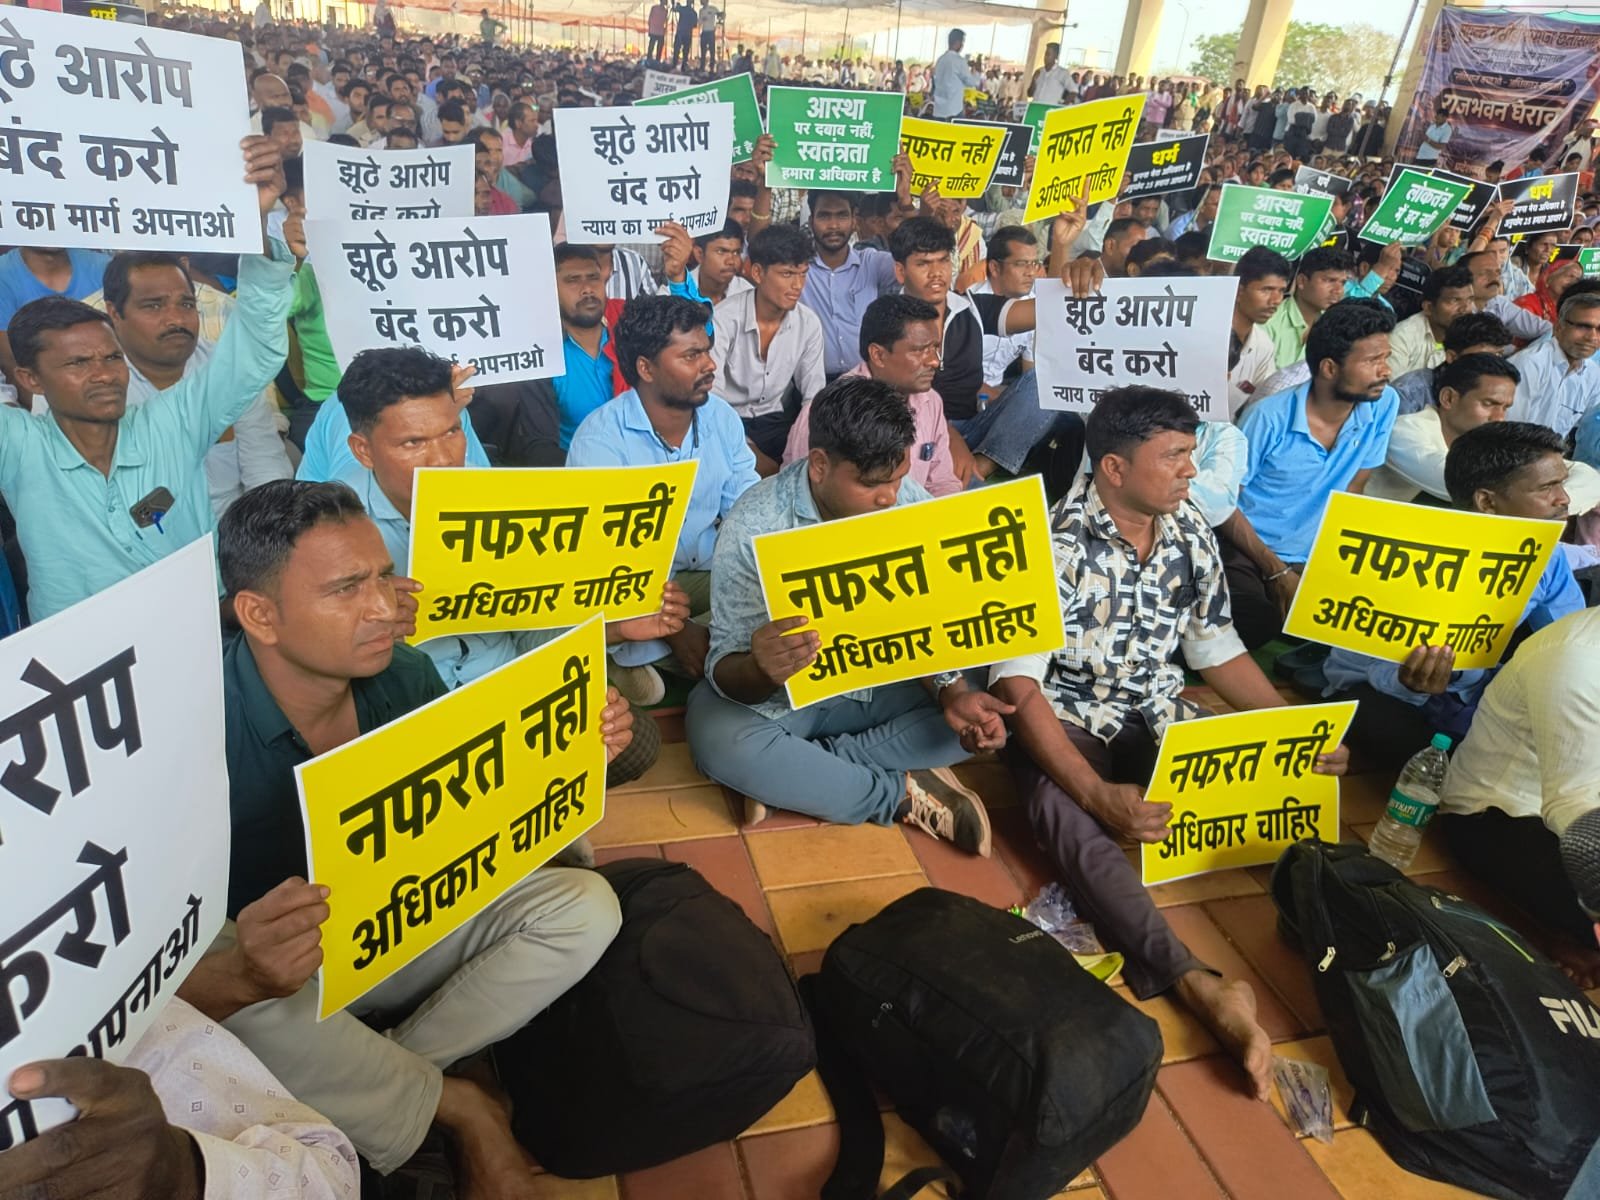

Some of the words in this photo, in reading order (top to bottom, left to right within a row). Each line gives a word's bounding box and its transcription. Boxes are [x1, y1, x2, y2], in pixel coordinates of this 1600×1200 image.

[55, 37, 192, 108] आरोप
[794, 122, 811, 136] पर
[806, 96, 866, 121] आस्था
[1441, 94, 1510, 121] राजभवन
[79, 126, 179, 185] करो
[591, 115, 636, 165] झूठे
[646, 112, 710, 153] आरोप
[797, 136, 869, 164] स्वतंत्रता
[961, 135, 995, 164] नहीं
[1047, 123, 1097, 163] नफरत
[1101, 107, 1136, 153] नहीं
[1152, 142, 1180, 165] धर्म
[337, 155, 381, 194] झूठे
[389, 155, 451, 189] आरोप
[608, 170, 648, 206] बंद
[656, 166, 701, 203] करो
[781, 166, 814, 181] हमारा
[818, 165, 867, 182] अधिकार
[872, 166, 882, 183] है
[946, 171, 981, 192] चाहिए
[1036, 175, 1082, 209] अधिकार
[1087, 162, 1118, 194] ाहिए
[1530, 178, 1554, 200] धर्म
[12, 201, 55, 231] का
[64, 197, 120, 234] मार्ग
[132, 204, 234, 238] अपनाओ
[581, 220, 616, 236] न्याय
[621, 220, 642, 236] का
[1254, 194, 1304, 216] आस्था
[343, 229, 397, 291] झूठे
[409, 227, 509, 279] आरोप
[1240, 226, 1298, 248] स्वतंत्रता
[371, 299, 418, 342] बंद
[428, 294, 501, 342] करो
[1064, 289, 1107, 335] झूठे
[1115, 284, 1198, 328] आरोप
[468, 344, 544, 376] अपनाओ
[1076, 342, 1114, 376] बंद
[1122, 341, 1178, 378] करो
[1053, 386, 1084, 404] न्याय
[439, 507, 589, 563] नफरत
[602, 482, 677, 548] नहीं
[781, 545, 930, 619] नफरत
[940, 506, 1028, 583] नहीं
[1338, 528, 1470, 592] नफरत
[1478, 537, 1542, 600] नहीं
[428, 582, 564, 622] अधिकार
[573, 565, 653, 608] चाहिए
[808, 626, 934, 681] अधिकार
[943, 601, 1038, 649] चाहिए
[1313, 595, 1439, 648] अधिकार
[1445, 615, 1504, 655] चाहिए
[0, 645, 142, 815] रोप
[339, 719, 505, 864] नफरत
[521, 654, 591, 759] नहीं
[1169, 741, 1267, 793] नफरत
[1274, 720, 1335, 778] नहीं
[1256, 796, 1321, 842] चाहिए
[353, 832, 499, 971] अधिकार
[510, 770, 588, 854] चाहिए
